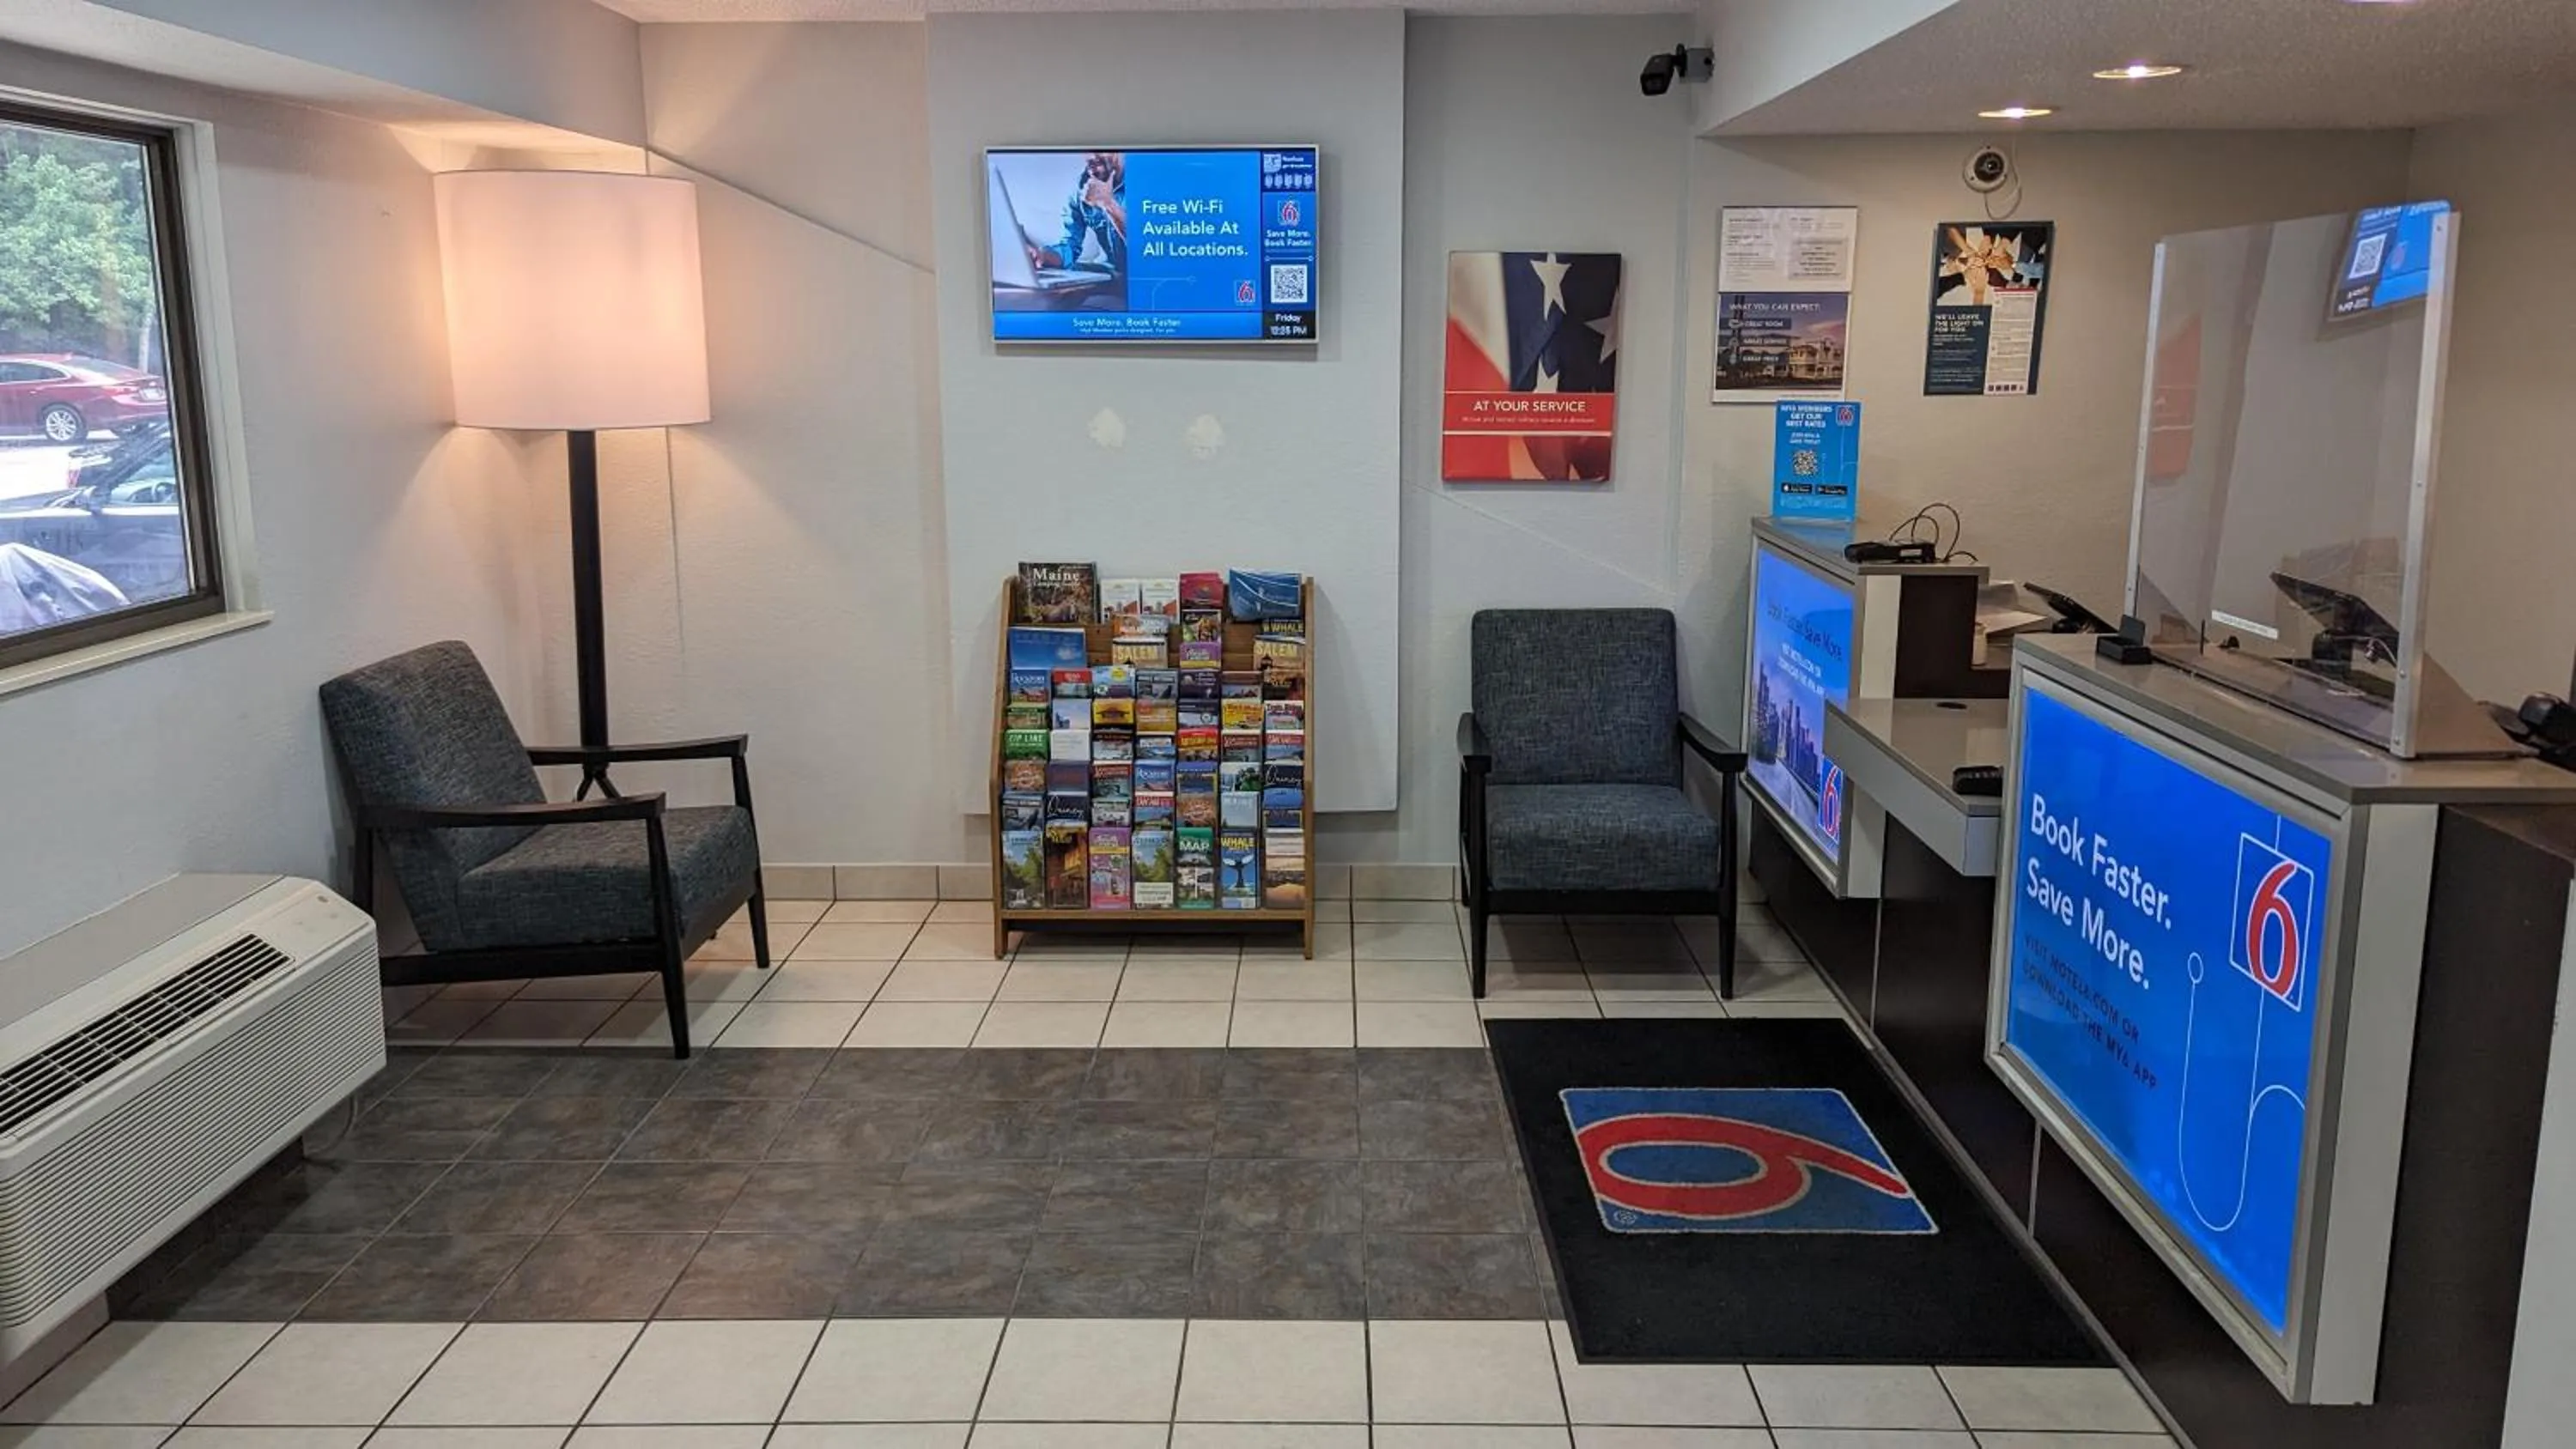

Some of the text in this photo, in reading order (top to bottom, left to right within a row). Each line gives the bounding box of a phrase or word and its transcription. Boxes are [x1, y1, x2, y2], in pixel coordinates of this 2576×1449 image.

[1142, 199, 1224, 214] Free Wi-Fi
[1142, 220, 1239, 234] Available At
[1142, 241, 1249, 257] All Locations.
[1729, 302, 1753, 311] WHAT
[1754, 302, 1769, 311] YOU
[1771, 302, 1789, 311] CAN
[1072, 317, 1094, 327] Save
[1126, 318, 1150, 327] Book
[1274, 313, 1303, 324] Friday
[1292, 325, 1308, 336] PM
[1473, 401, 1587, 413] AT YOUR SERVICE
[1033, 567, 1079, 581] Maine
[1117, 646, 1158, 660] SALEM
[1256, 641, 1297, 658] SALEM
[1825, 764, 1841, 836] 6
[1179, 840, 1210, 851] MAP
[1221, 837, 1255, 848] WHALE
[2031, 792, 2172, 930] Book Faster.
[2026, 856, 2150, 991] Save More.
[2246, 859, 2300, 999] 6
[2025, 933, 2048, 960] VISIT
[2121, 1016, 2140, 1045] OR
[2023, 958, 2080, 1020] DOWNLOAD
[2081, 1011, 2103, 1042] THE
[2133, 1060, 2158, 1088] APP
[1577, 1113, 1826, 1221] 6
